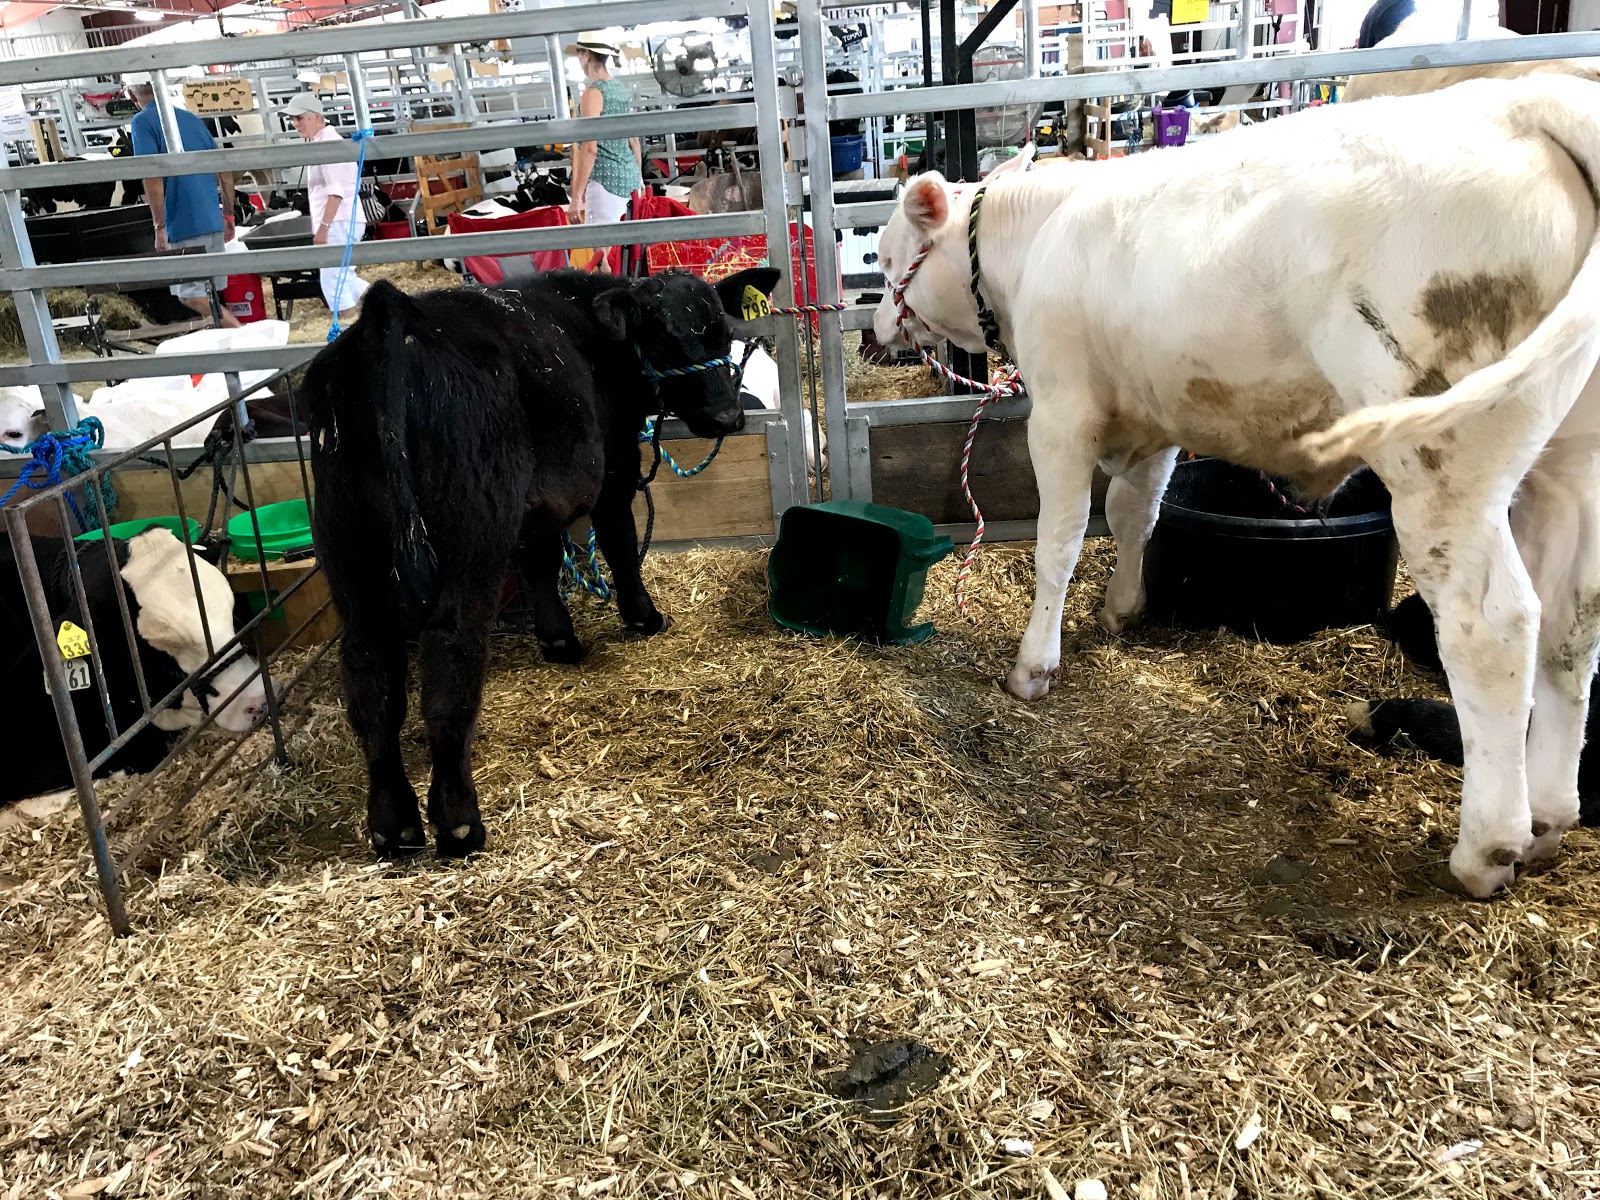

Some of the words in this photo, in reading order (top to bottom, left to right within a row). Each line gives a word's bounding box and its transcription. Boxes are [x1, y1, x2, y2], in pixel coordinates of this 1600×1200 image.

[842, 30, 863, 42] TOMMY
[743, 299, 769, 320] 798
[69, 667, 90, 689] 61
